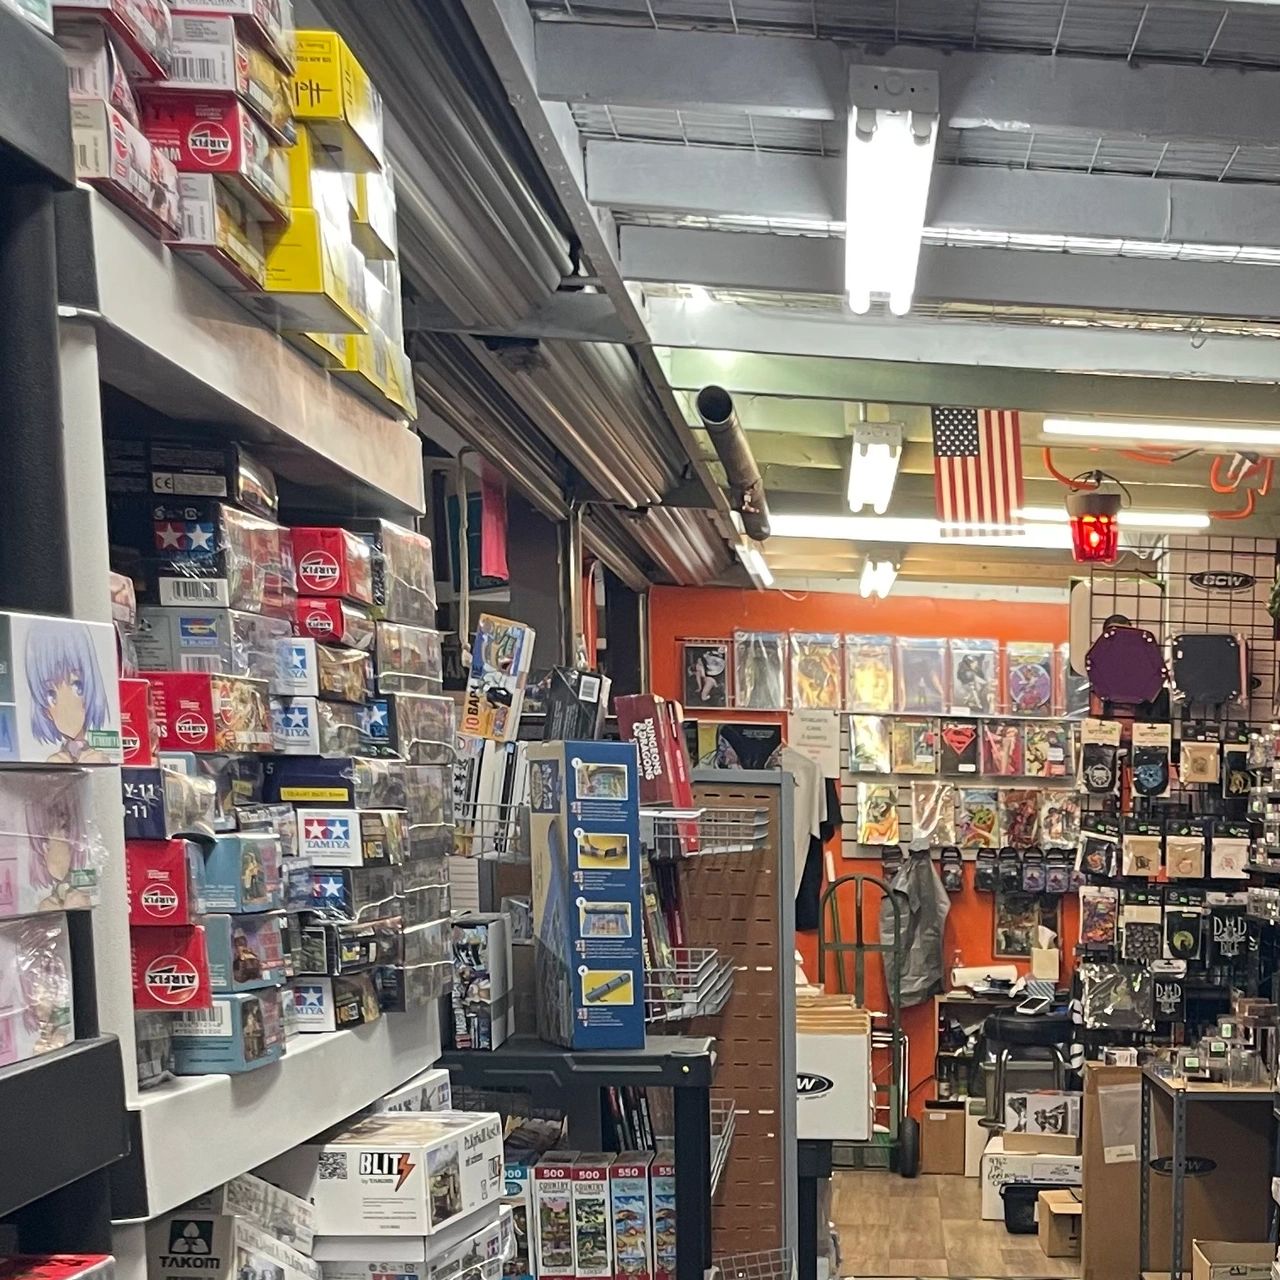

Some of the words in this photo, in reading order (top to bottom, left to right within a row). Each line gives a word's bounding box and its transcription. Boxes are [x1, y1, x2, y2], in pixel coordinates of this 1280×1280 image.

[190, 136, 230, 154] AIRFIX
[300, 563, 339, 576] AIRFIX
[1202, 575, 1243, 586] BCW
[177, 723, 208, 733] AIRFIX
[637, 723, 654, 781] DRAGONS
[643, 718, 662, 776] DUNGEONS
[305, 840, 350, 849] TAMIYA
[143, 896, 176, 905] AIRFIX
[148, 973, 195, 984] AIRFIX
[544, 1169, 565, 1178] 500
[579, 1171, 600, 1180] 500
[618, 1168, 638, 1177] 550
[159, 1256, 220, 1269] TAKOM
